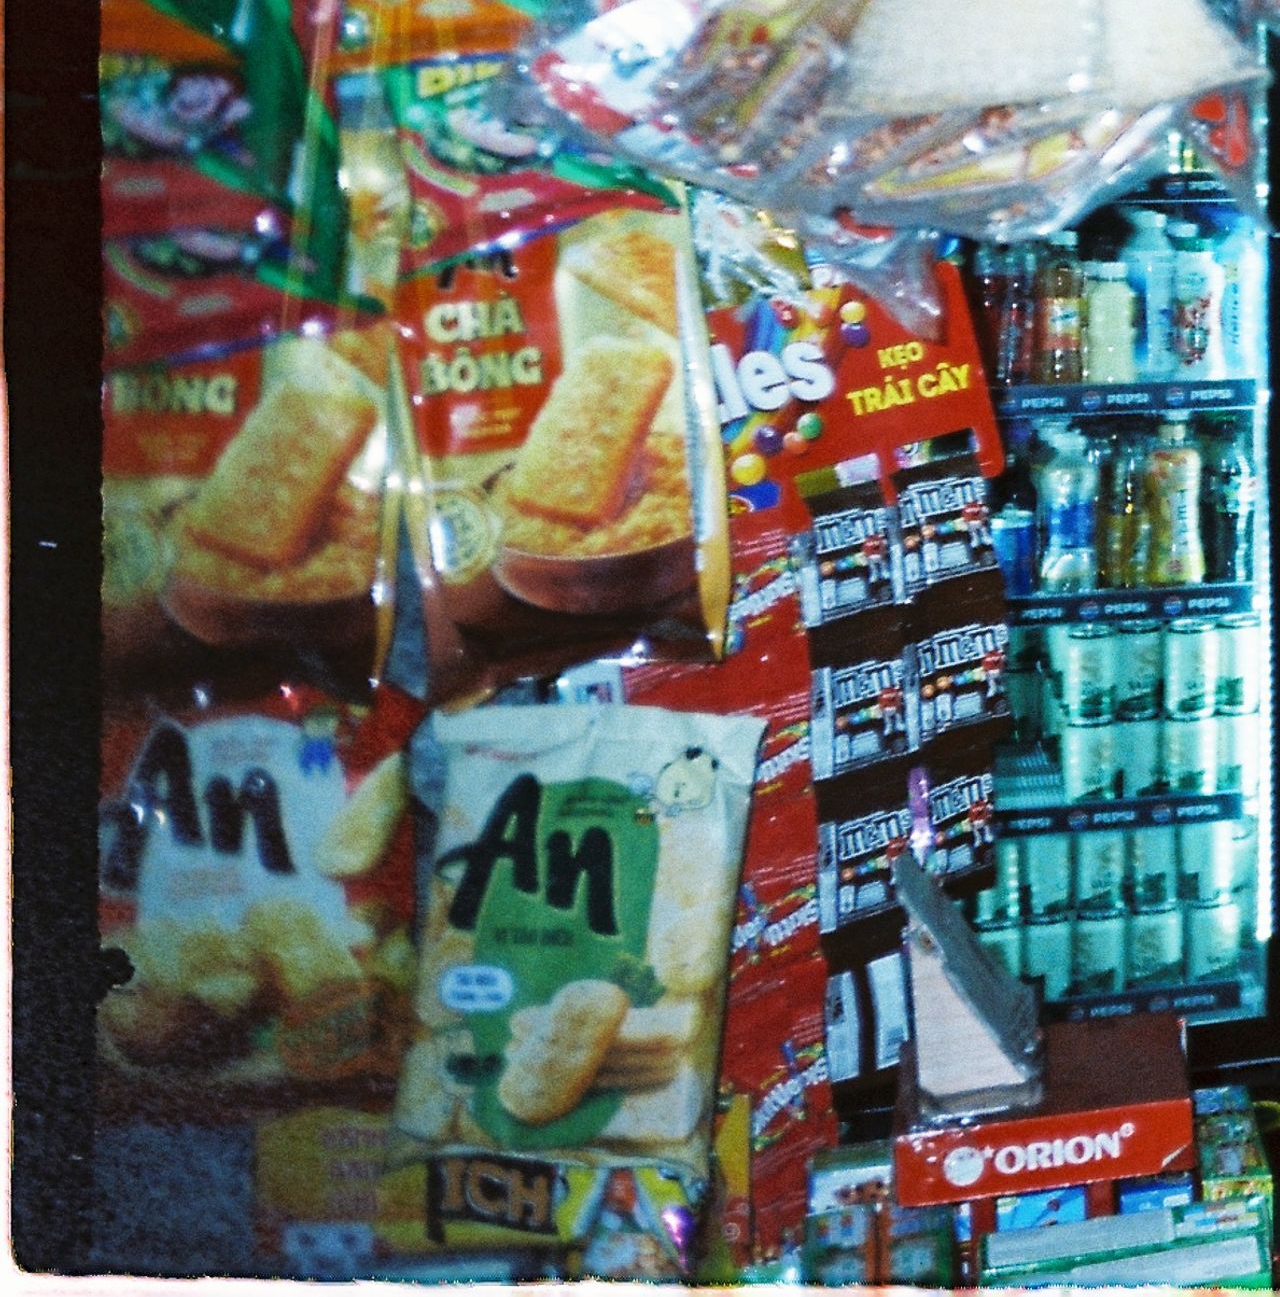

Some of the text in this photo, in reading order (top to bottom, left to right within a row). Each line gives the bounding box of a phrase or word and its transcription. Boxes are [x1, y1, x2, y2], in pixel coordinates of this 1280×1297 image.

[877, 341, 926, 371] KẸO
[846, 362, 971, 417] TRÁI CÂY
[434, 771, 622, 937] An
[993, 1133, 1124, 1175] ORION
